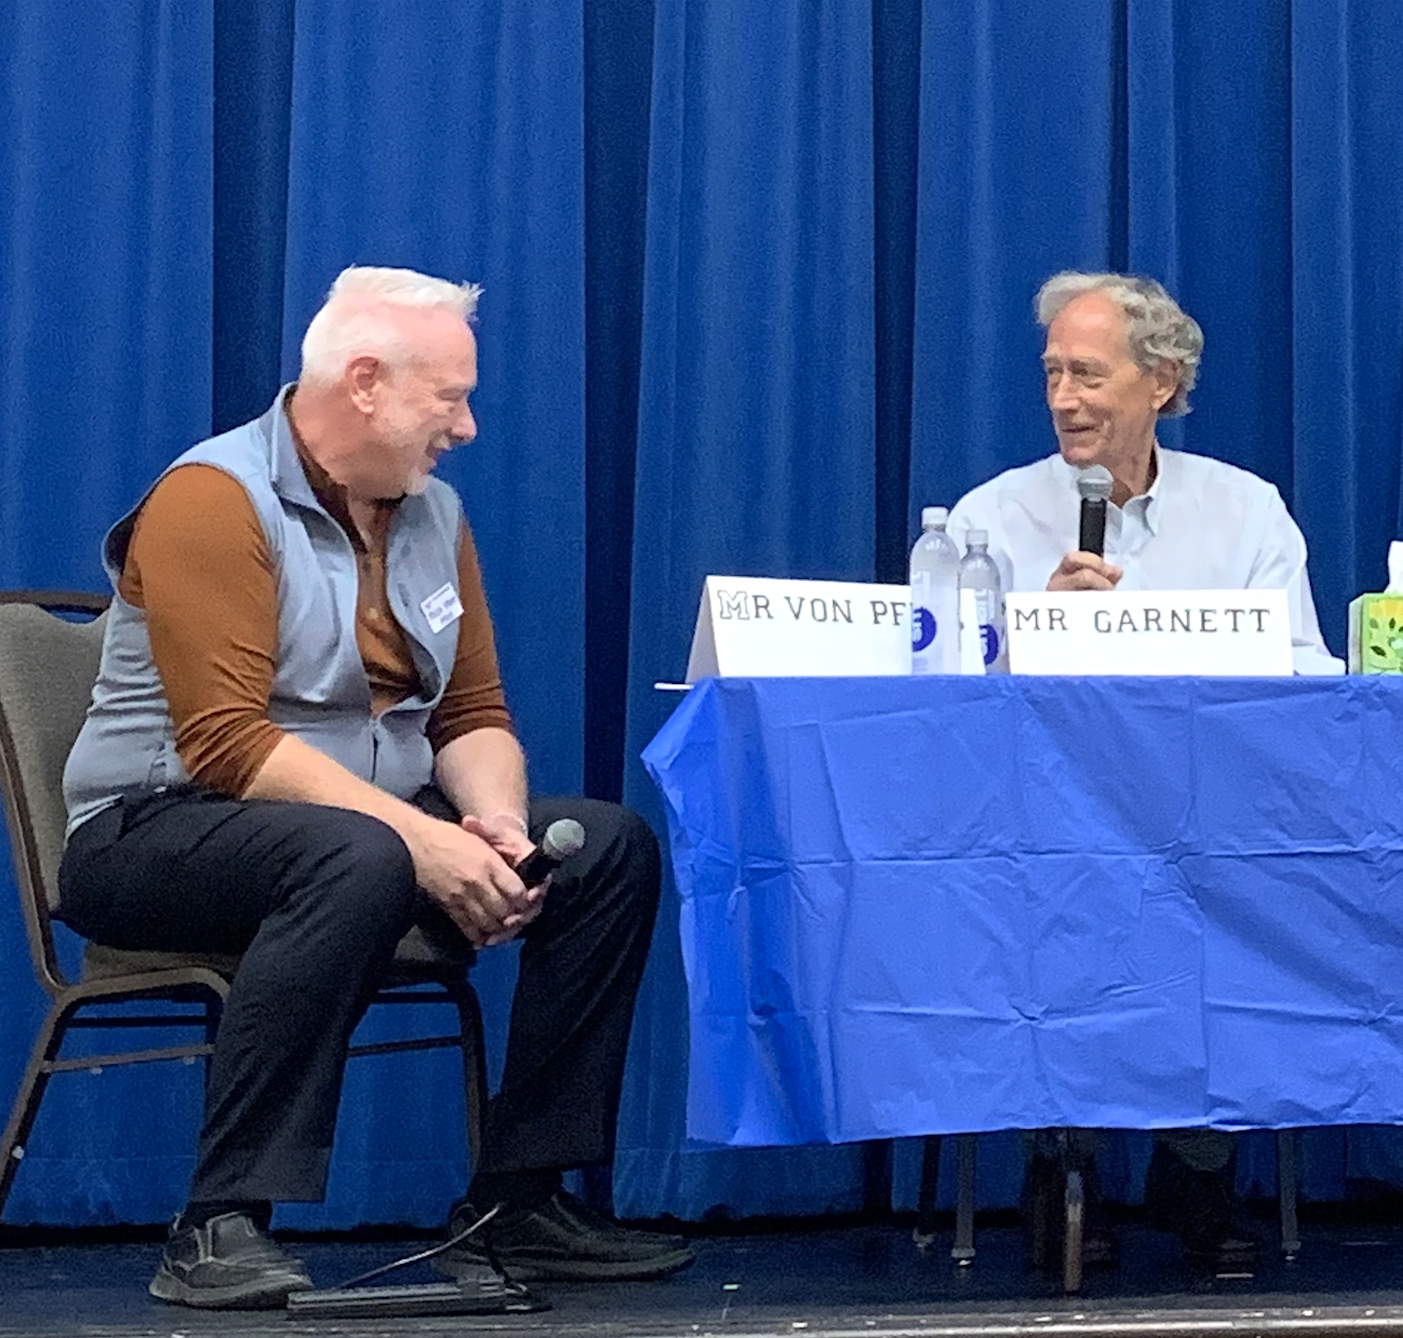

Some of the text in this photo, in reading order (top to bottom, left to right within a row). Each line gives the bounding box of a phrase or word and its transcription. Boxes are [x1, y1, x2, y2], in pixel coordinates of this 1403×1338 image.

[717, 590, 914, 626] MR VON PF
[1013, 608, 1270, 633] MR GARNETT
